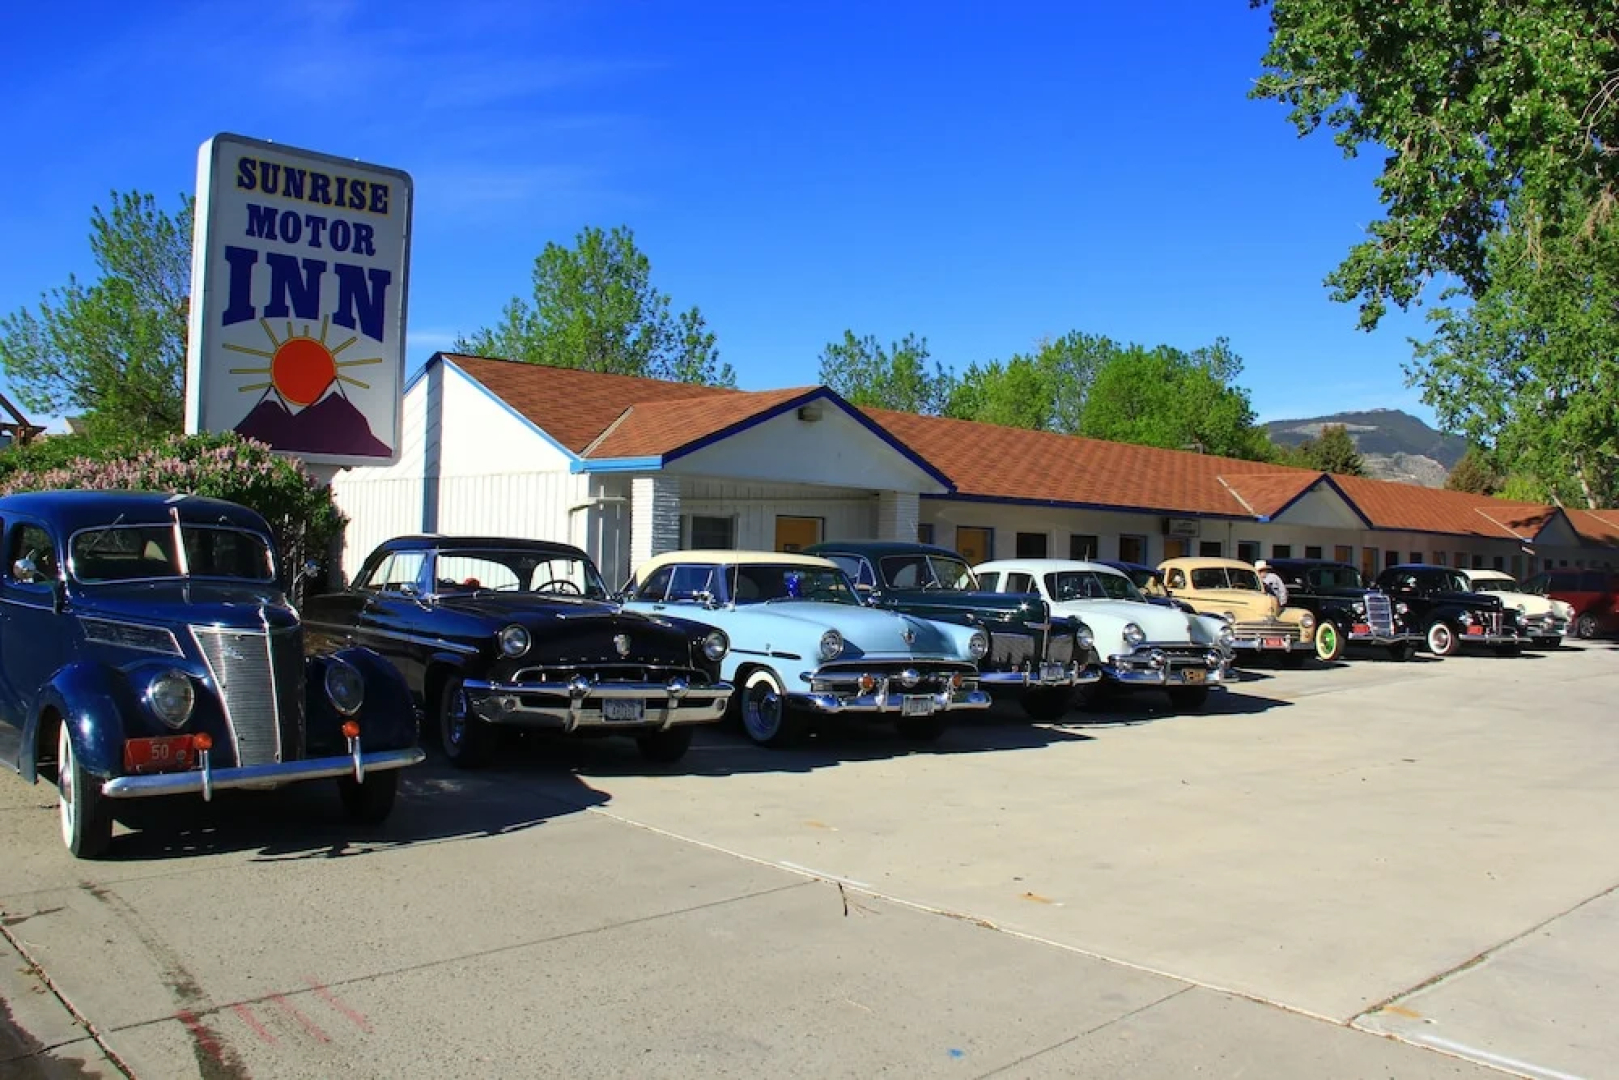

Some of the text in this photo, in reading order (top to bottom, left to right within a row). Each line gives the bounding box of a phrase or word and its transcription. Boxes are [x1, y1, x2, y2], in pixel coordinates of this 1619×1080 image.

[237, 156, 390, 215] SUNRISE
[245, 203, 377, 257] MOTOR
[221, 245, 392, 343] INN
